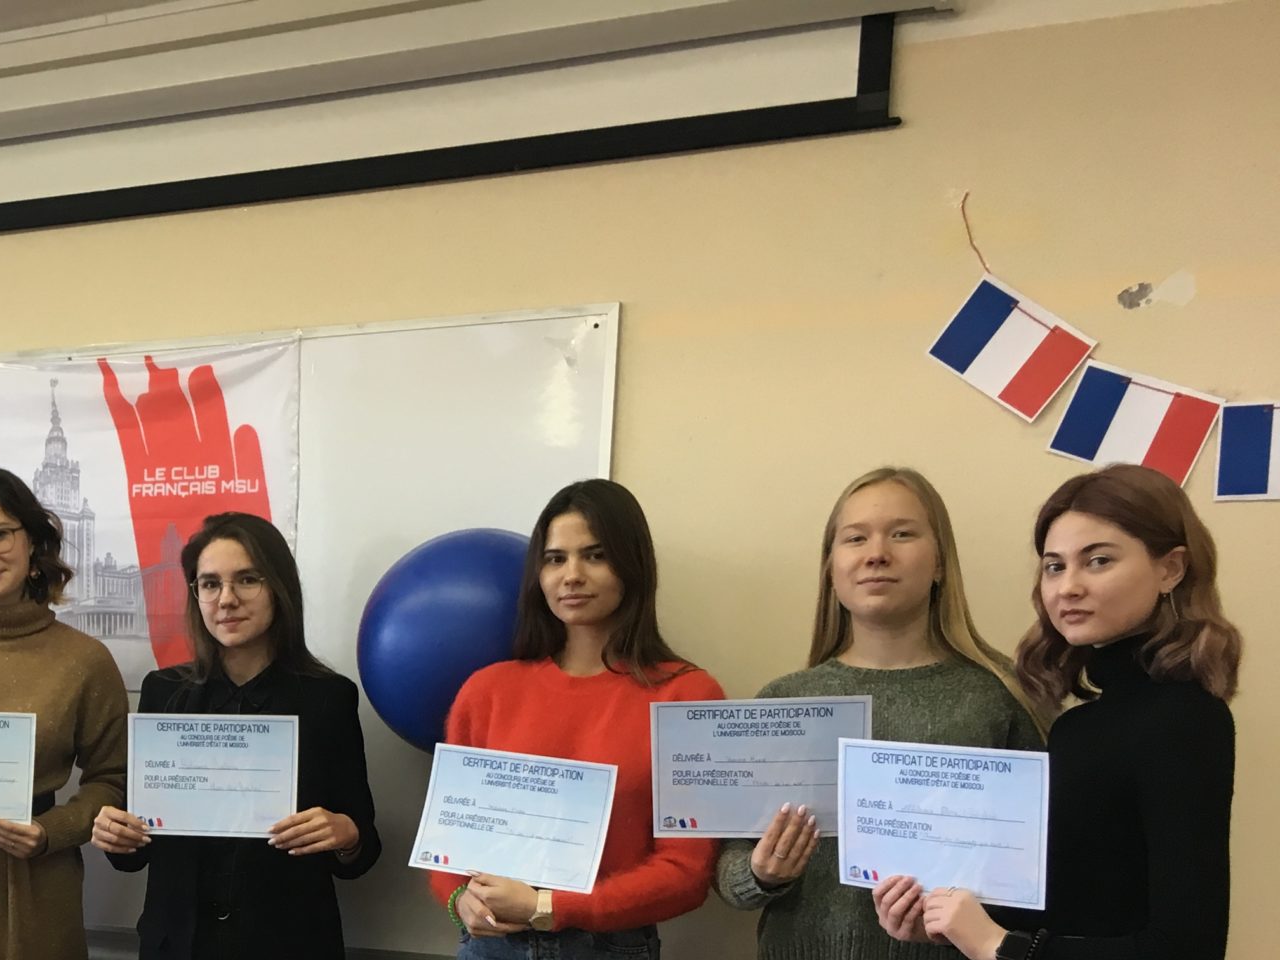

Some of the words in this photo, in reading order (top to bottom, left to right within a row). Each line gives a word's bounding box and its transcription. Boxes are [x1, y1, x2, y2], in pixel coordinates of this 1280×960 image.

[144, 468, 166, 482] LE
[172, 465, 220, 480] CLUB
[132, 480, 217, 498] FRANÇAIS
[221, 478, 259, 494] MSU
[687, 709, 741, 719] CERTIFICAT
[744, 708, 756, 719] DE
[760, 707, 832, 718] PARTICIPATION
[156, 722, 198, 732] CERTIFICAT
[201, 723, 211, 732] DE
[213, 723, 269, 733] PARTICIPATION
[672, 753, 704, 762] DÉLIVRÉE
[706, 753, 711, 762] À
[872, 751, 923, 766] CERTIFICAT
[926, 756, 937, 768] DE
[941, 757, 1011, 774] PARTICIPATION
[144, 760, 169, 768] DÉLIVRÉE
[462, 756, 507, 771] CERTIFICAT
[509, 762, 521, 773] DE
[522, 763, 584, 780] PARTICIPATION
[909, 770, 940, 778] CONCOURS
[950, 772, 970, 781] POÉSIE
[443, 795, 470, 806] DÉLIVRÉE
[471, 798, 476, 807] À
[857, 798, 886, 809] DÉLIVRÉE
[888, 801, 892, 810] À
[438, 818, 485, 830] EXCEPTIONNELLE
[464, 813, 508, 826] PRÉSENTATION
[857, 817, 874, 825] POUR
[884, 818, 931, 831] PRÉSENTATION
[857, 826, 910, 838] EXCEPTIONNELLE
